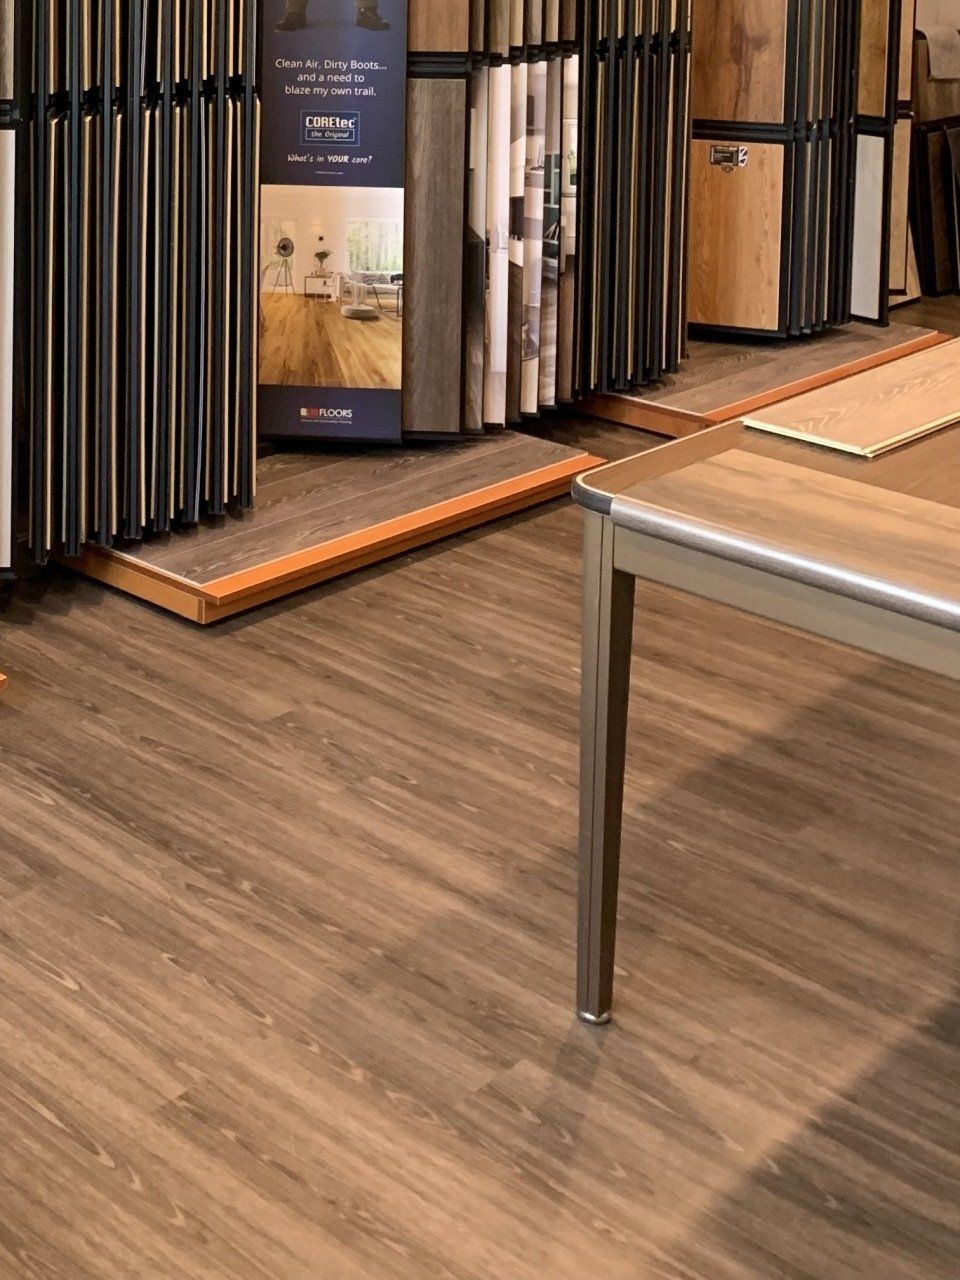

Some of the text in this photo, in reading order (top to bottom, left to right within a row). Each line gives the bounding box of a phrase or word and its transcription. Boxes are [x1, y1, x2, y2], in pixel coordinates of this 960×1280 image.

[275, 59, 303, 68] Clean
[305, 60, 321, 70] Air,
[324, 60, 348, 71] Dirty
[297, 73, 316, 82] and
[327, 73, 352, 82] need
[354, 74, 365, 83] to
[285, 85, 377, 97] blaze my own trail.
[305, 116, 355, 128] COREtec
[287, 153, 314, 162] What's
[327, 155, 349, 163] YOUR
[351, 155, 373, 164] core?
